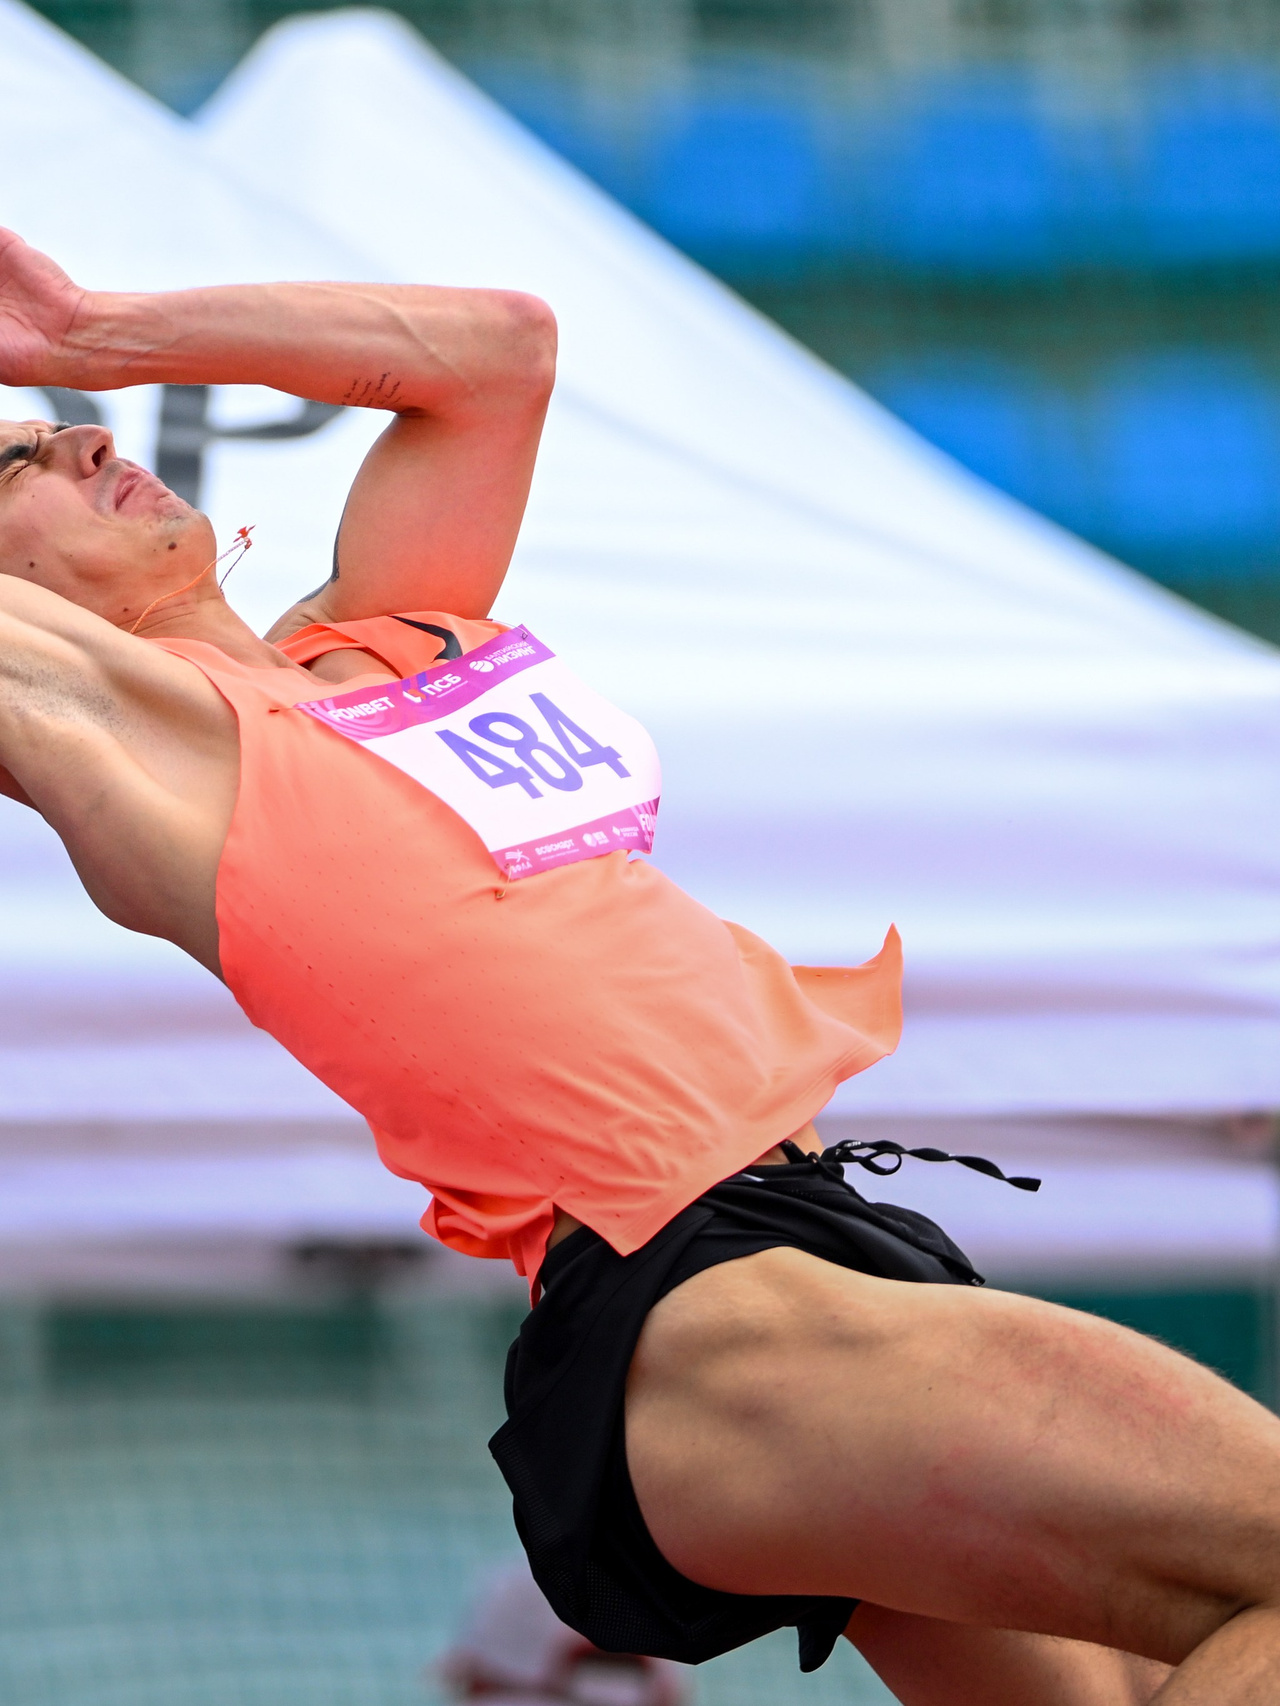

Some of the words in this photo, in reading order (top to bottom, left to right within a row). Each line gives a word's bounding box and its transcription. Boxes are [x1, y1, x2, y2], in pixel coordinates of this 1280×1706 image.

[492, 645, 537, 666] ЛИЗИНГ
[420, 673, 462, 696] ПСБ
[327, 696, 396, 722] FONBET
[434, 692, 632, 800] 484
